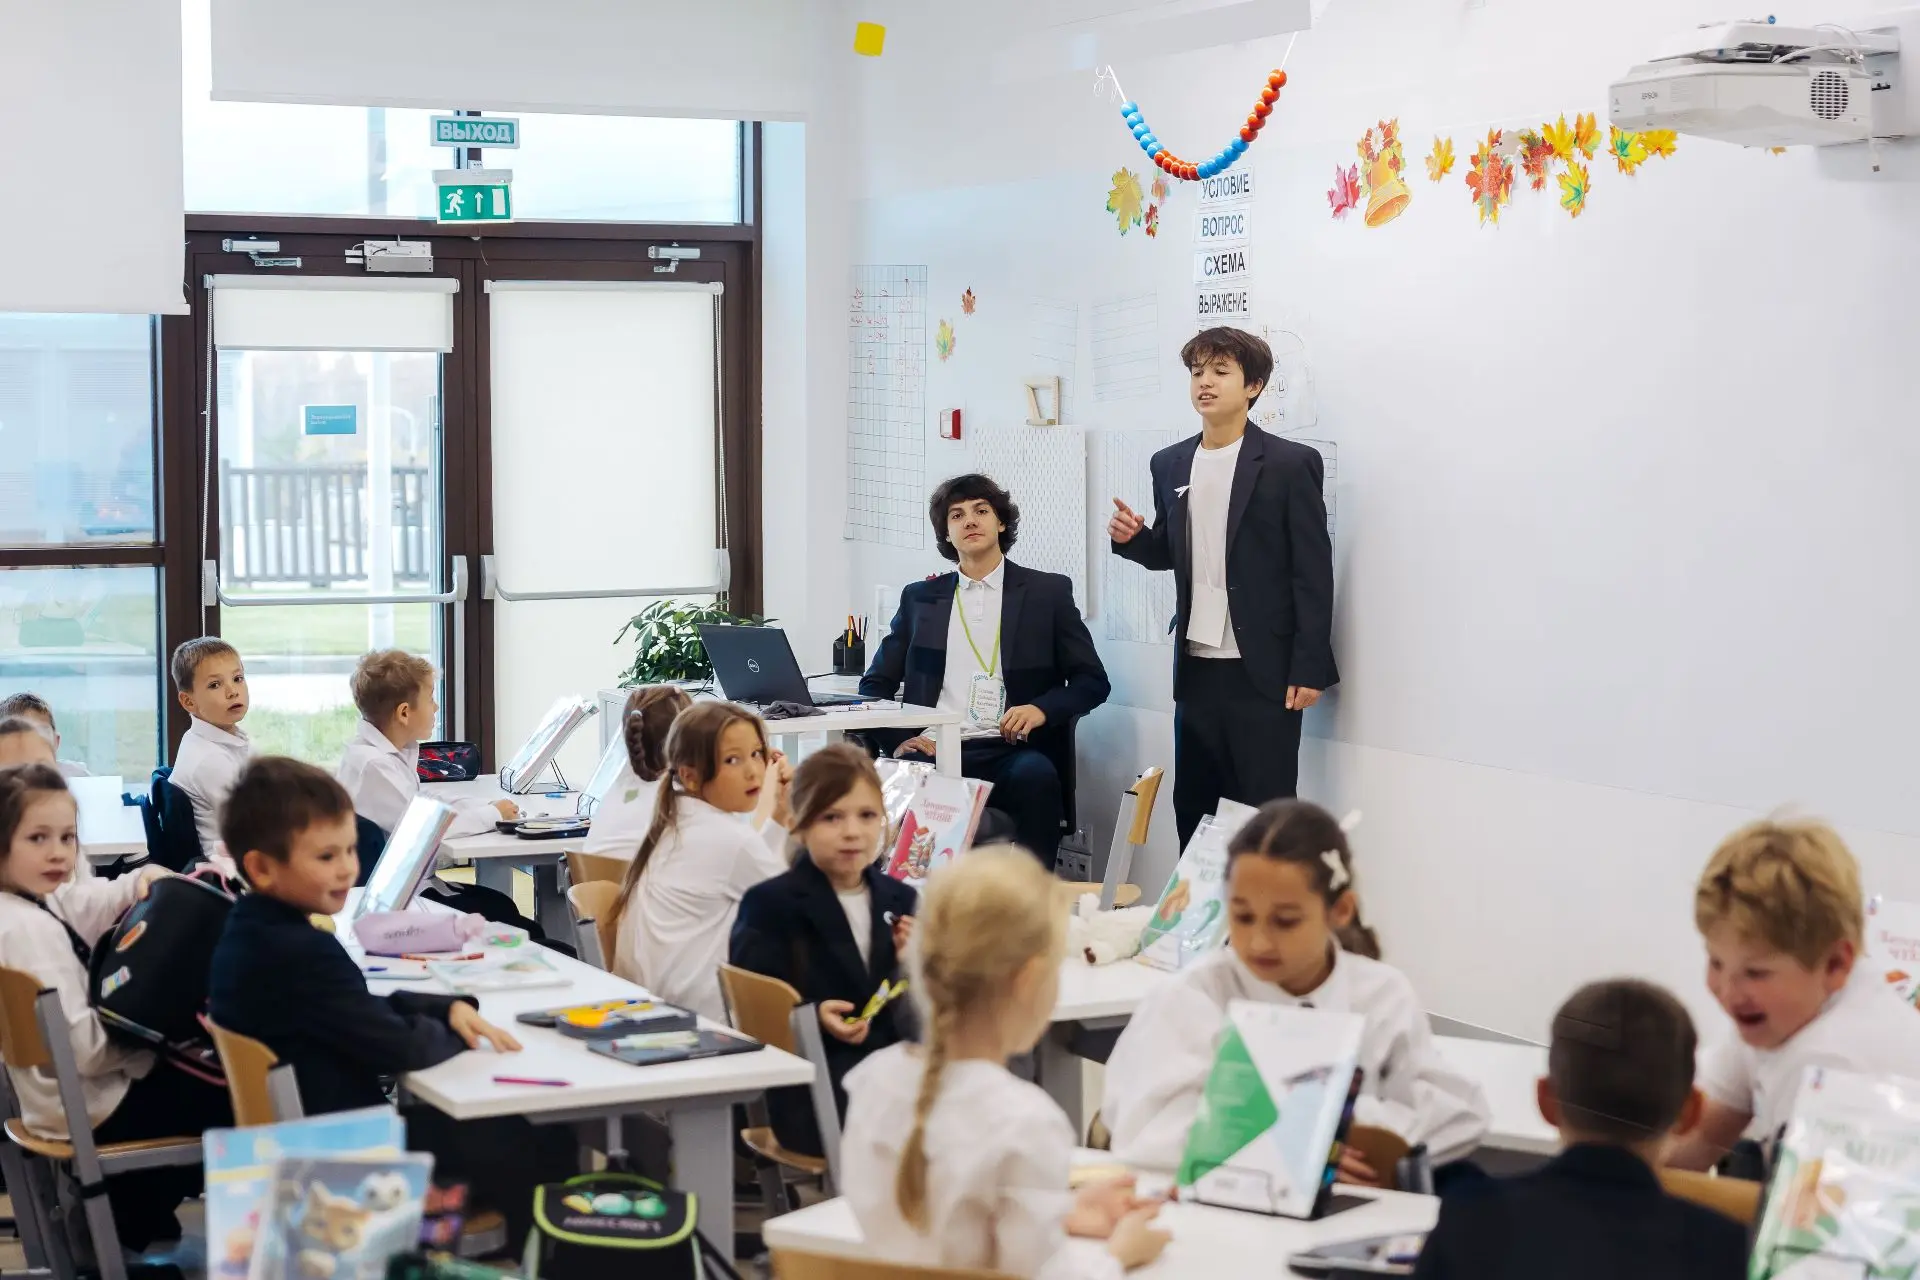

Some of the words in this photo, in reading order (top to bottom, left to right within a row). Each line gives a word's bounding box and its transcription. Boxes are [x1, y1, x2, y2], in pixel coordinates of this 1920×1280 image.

[439, 122, 511, 142] ВЫХОД
[1202, 173, 1250, 199] УСЛОВИЕ
[1202, 214, 1244, 237] ВОПРОС
[1204, 252, 1246, 276] СХЕМА
[1198, 292, 1248, 314] ВЫРАЖЕНИЕ
